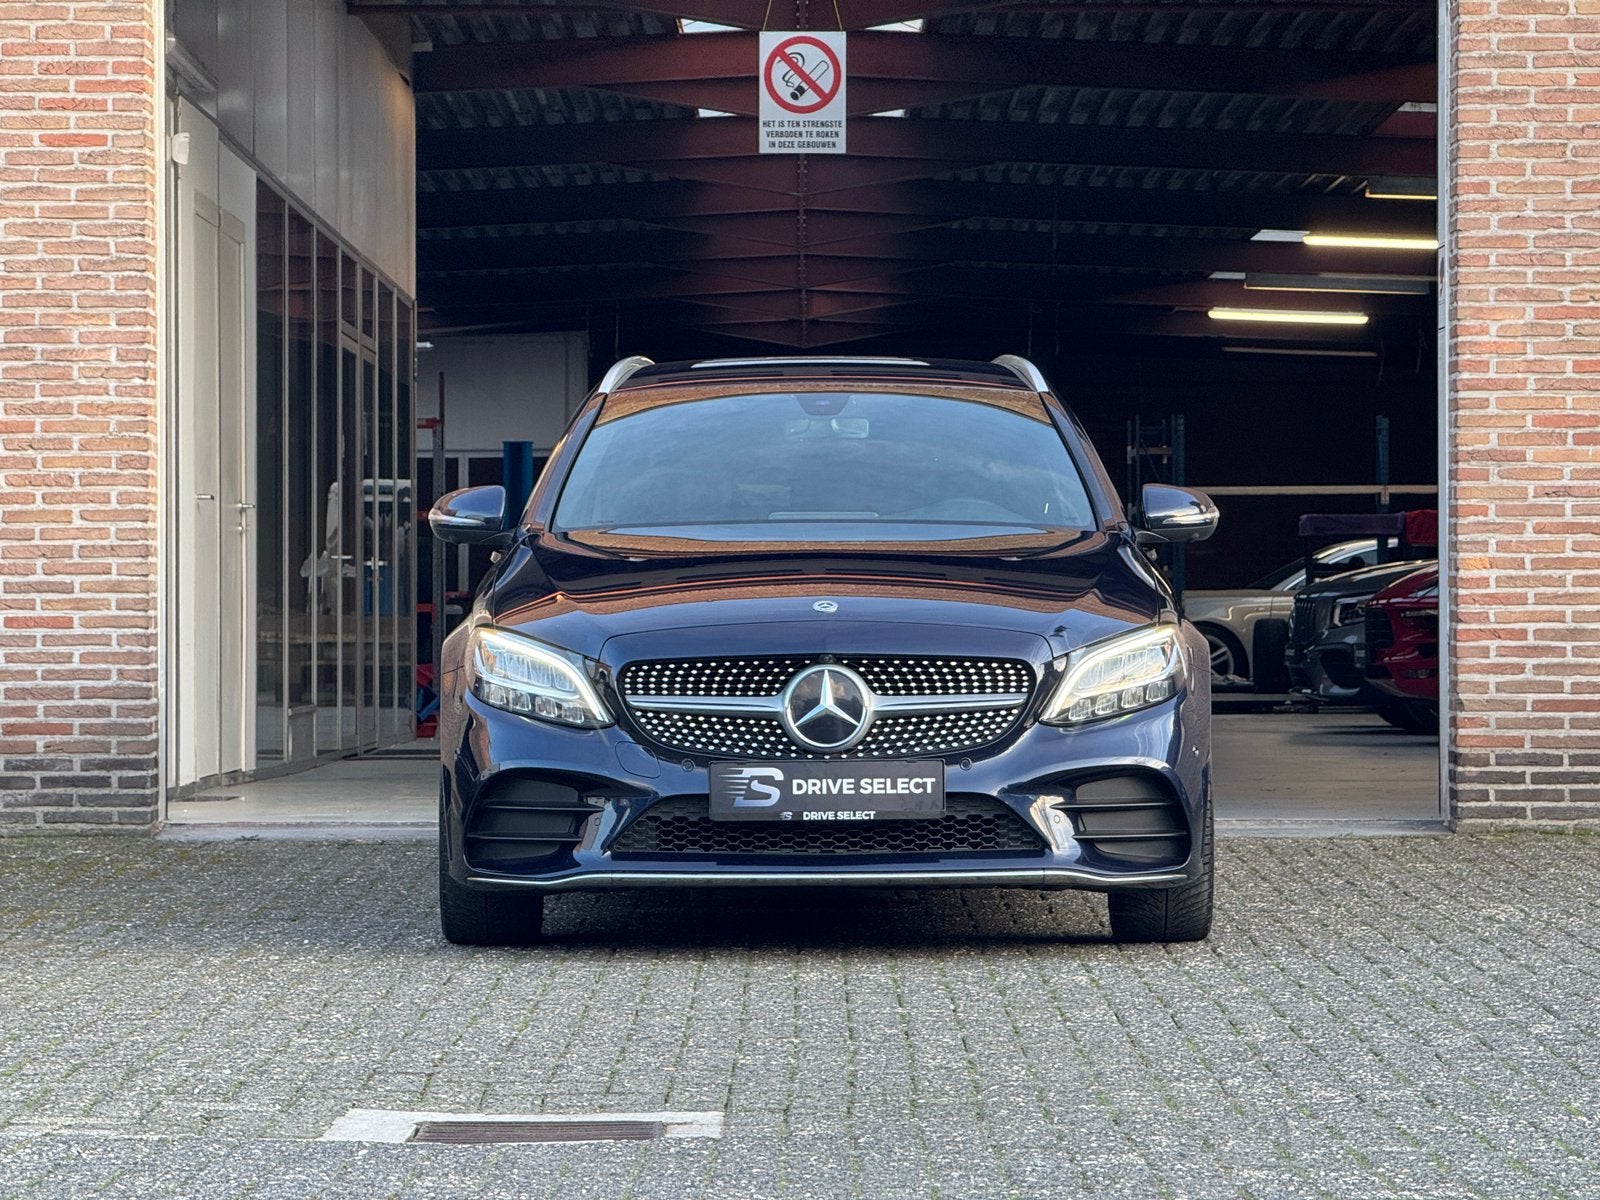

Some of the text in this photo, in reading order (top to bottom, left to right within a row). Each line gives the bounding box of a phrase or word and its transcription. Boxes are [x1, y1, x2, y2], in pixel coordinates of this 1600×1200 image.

[762, 120, 843, 128] HET IS TEN STRENGSTE
[766, 130, 840, 138] VERBODEN TE ROKEN
[768, 140, 837, 148] IN DEZE GEBOUWEN
[792, 777, 936, 795] DRIVE SELECT
[802, 811, 836, 821] DRIVE
[836, 810, 876, 820] SELECT
